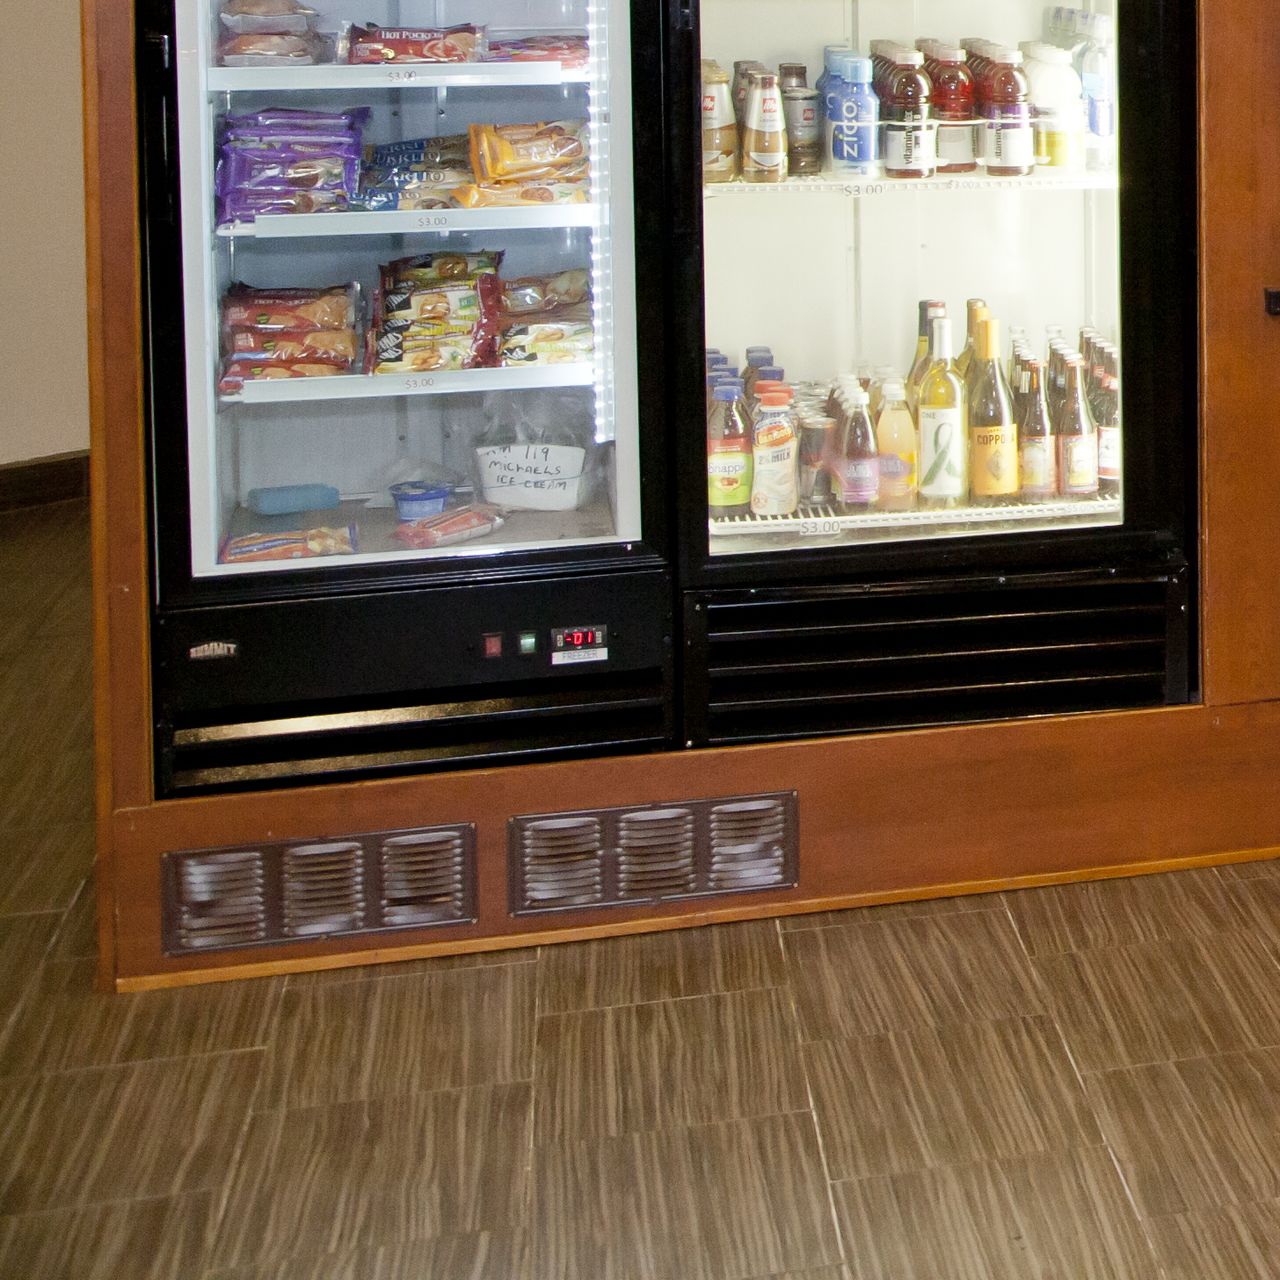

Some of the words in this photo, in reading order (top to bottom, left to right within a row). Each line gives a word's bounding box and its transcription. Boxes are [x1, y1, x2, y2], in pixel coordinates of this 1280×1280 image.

[382, 31, 400, 39] HOT
[844, 184, 883, 196] $3.00
[418, 217, 447, 226] $3.00
[405, 378, 434, 389] $3.00
[525, 445, 549, 461] 119
[772, 453, 791, 463] MILK
[489, 460, 561, 475] MICHAELS
[497, 475, 514, 485] ICE
[801, 522, 840, 534] $3.00
